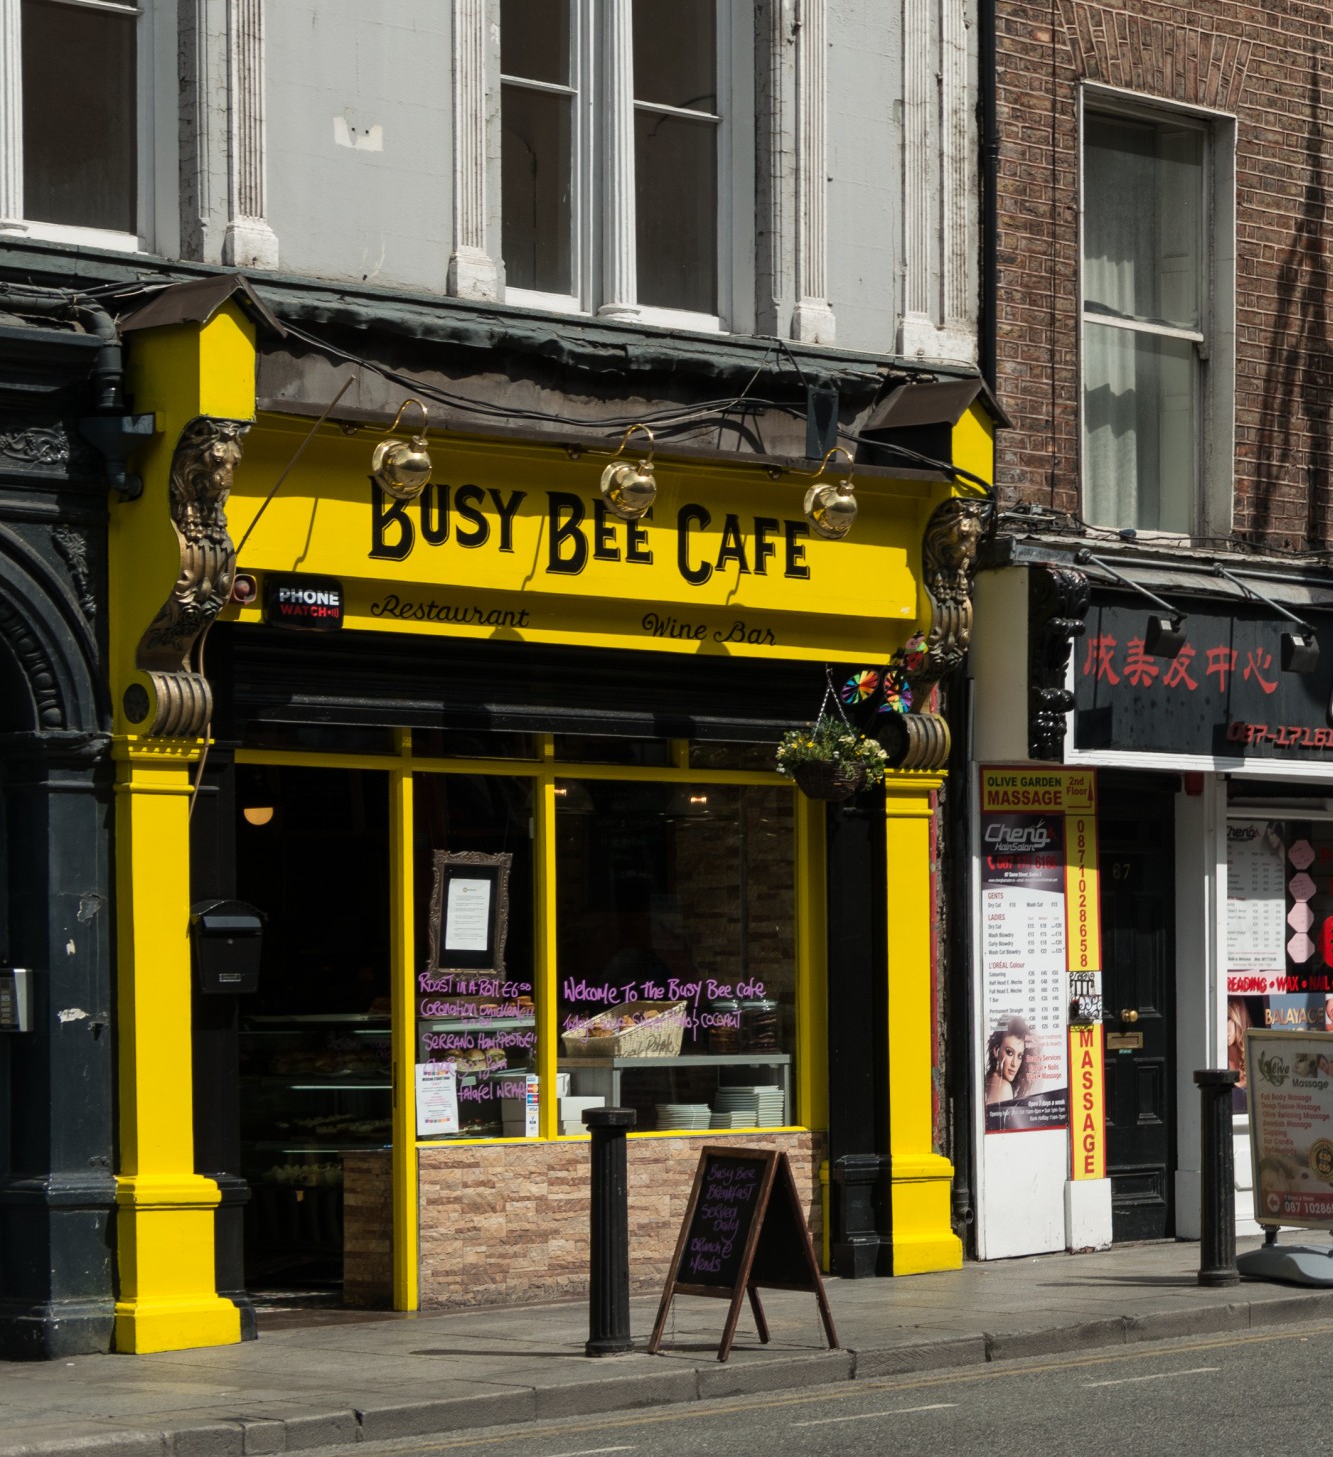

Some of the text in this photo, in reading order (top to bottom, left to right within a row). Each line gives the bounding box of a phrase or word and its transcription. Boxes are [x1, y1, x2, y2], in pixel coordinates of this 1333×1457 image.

[279, 587, 340, 605] PHONE
[280, 603, 328, 618] WATCH
[370, 593, 531, 629] Restaurant
[641, 612, 777, 647] Wine Bar
[988, 777, 1062, 787] OLIVE GARDEN
[1068, 777, 1084, 786] 2nd
[988, 790, 1062, 805] MASSAGE
[1066, 786, 1087, 796] Floor
[984, 824, 1051, 848] Cheng
[1112, 863, 1131, 879] 67
[988, 892, 1004, 900] GENTS
[1077, 819, 1088, 967] 0871028658
[1276, 976, 1298, 991] WAX
[1310, 976, 1330, 991] NAIL
[564, 976, 620, 1004] Welcome
[668, 979, 701, 1007] Busy
[706, 979, 733, 1000] Bee
[1264, 1007, 1324, 1025] BALAYAGE
[1292, 1079, 1329, 1090] Massage
[1080, 1030, 1095, 1174] MASSAGE
[1285, 1202, 1300, 1212] 087
